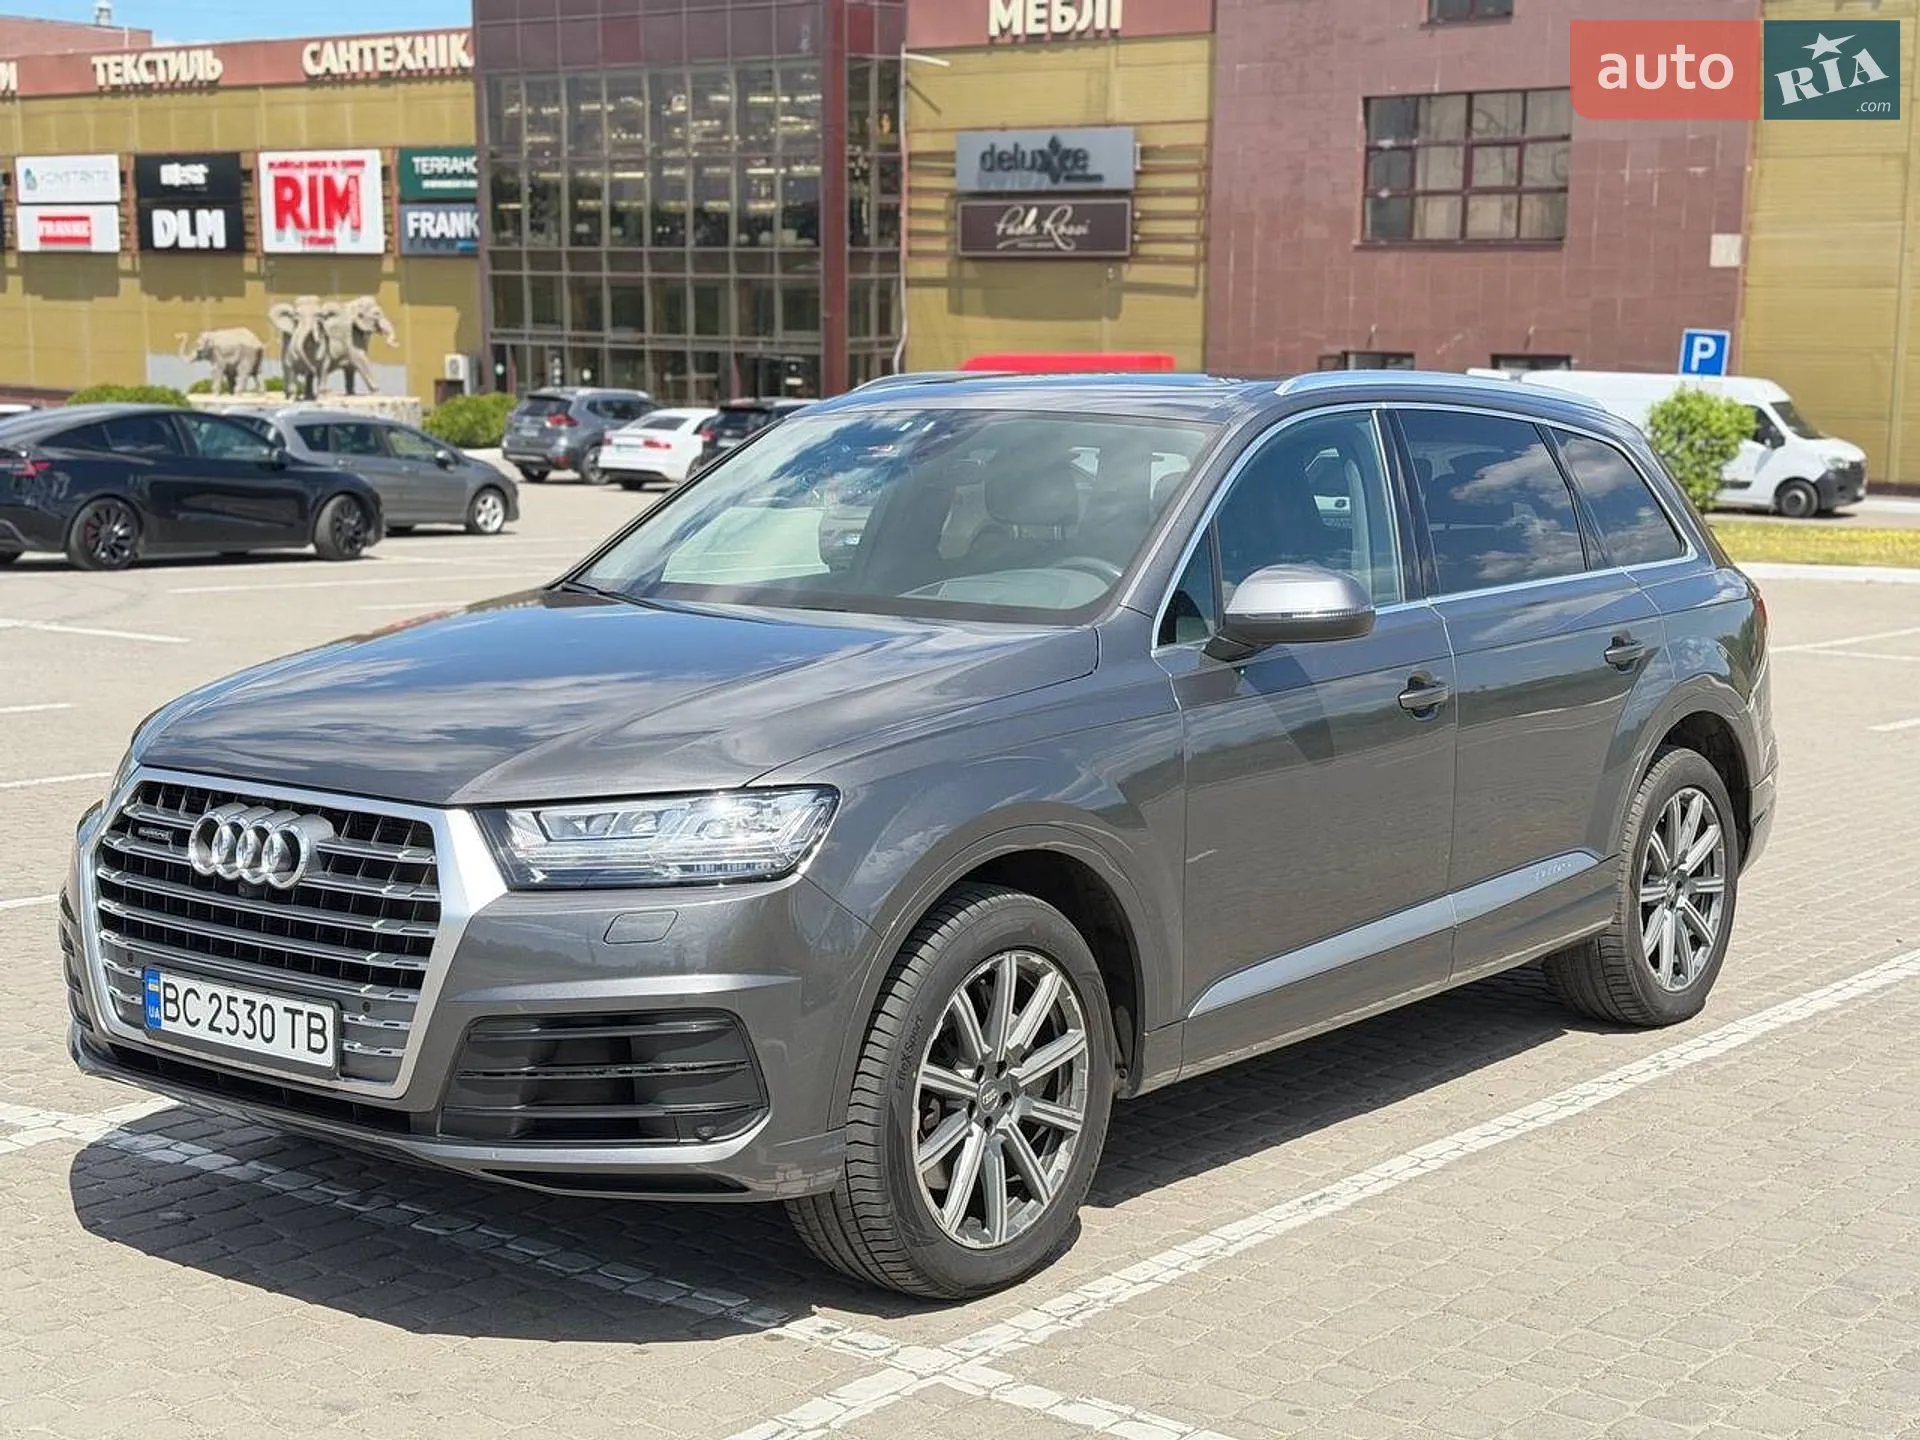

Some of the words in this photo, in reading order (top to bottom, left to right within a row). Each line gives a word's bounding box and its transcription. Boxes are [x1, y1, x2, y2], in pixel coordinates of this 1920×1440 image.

[989, 0, 1122, 36] МЕБЛІ
[91, 50, 223, 86] ТЕКСТИЛЬ
[302, 33, 474, 76] САНТЕХНІК
[274, 174, 361, 231] RIM
[152, 208, 226, 249] DLM
[1690, 335, 1717, 372] P
[148, 1005, 161, 1019] UA
[163, 982, 201, 1028] BC
[208, 992, 276, 1044] 2530
[283, 1006, 328, 1055] TB
